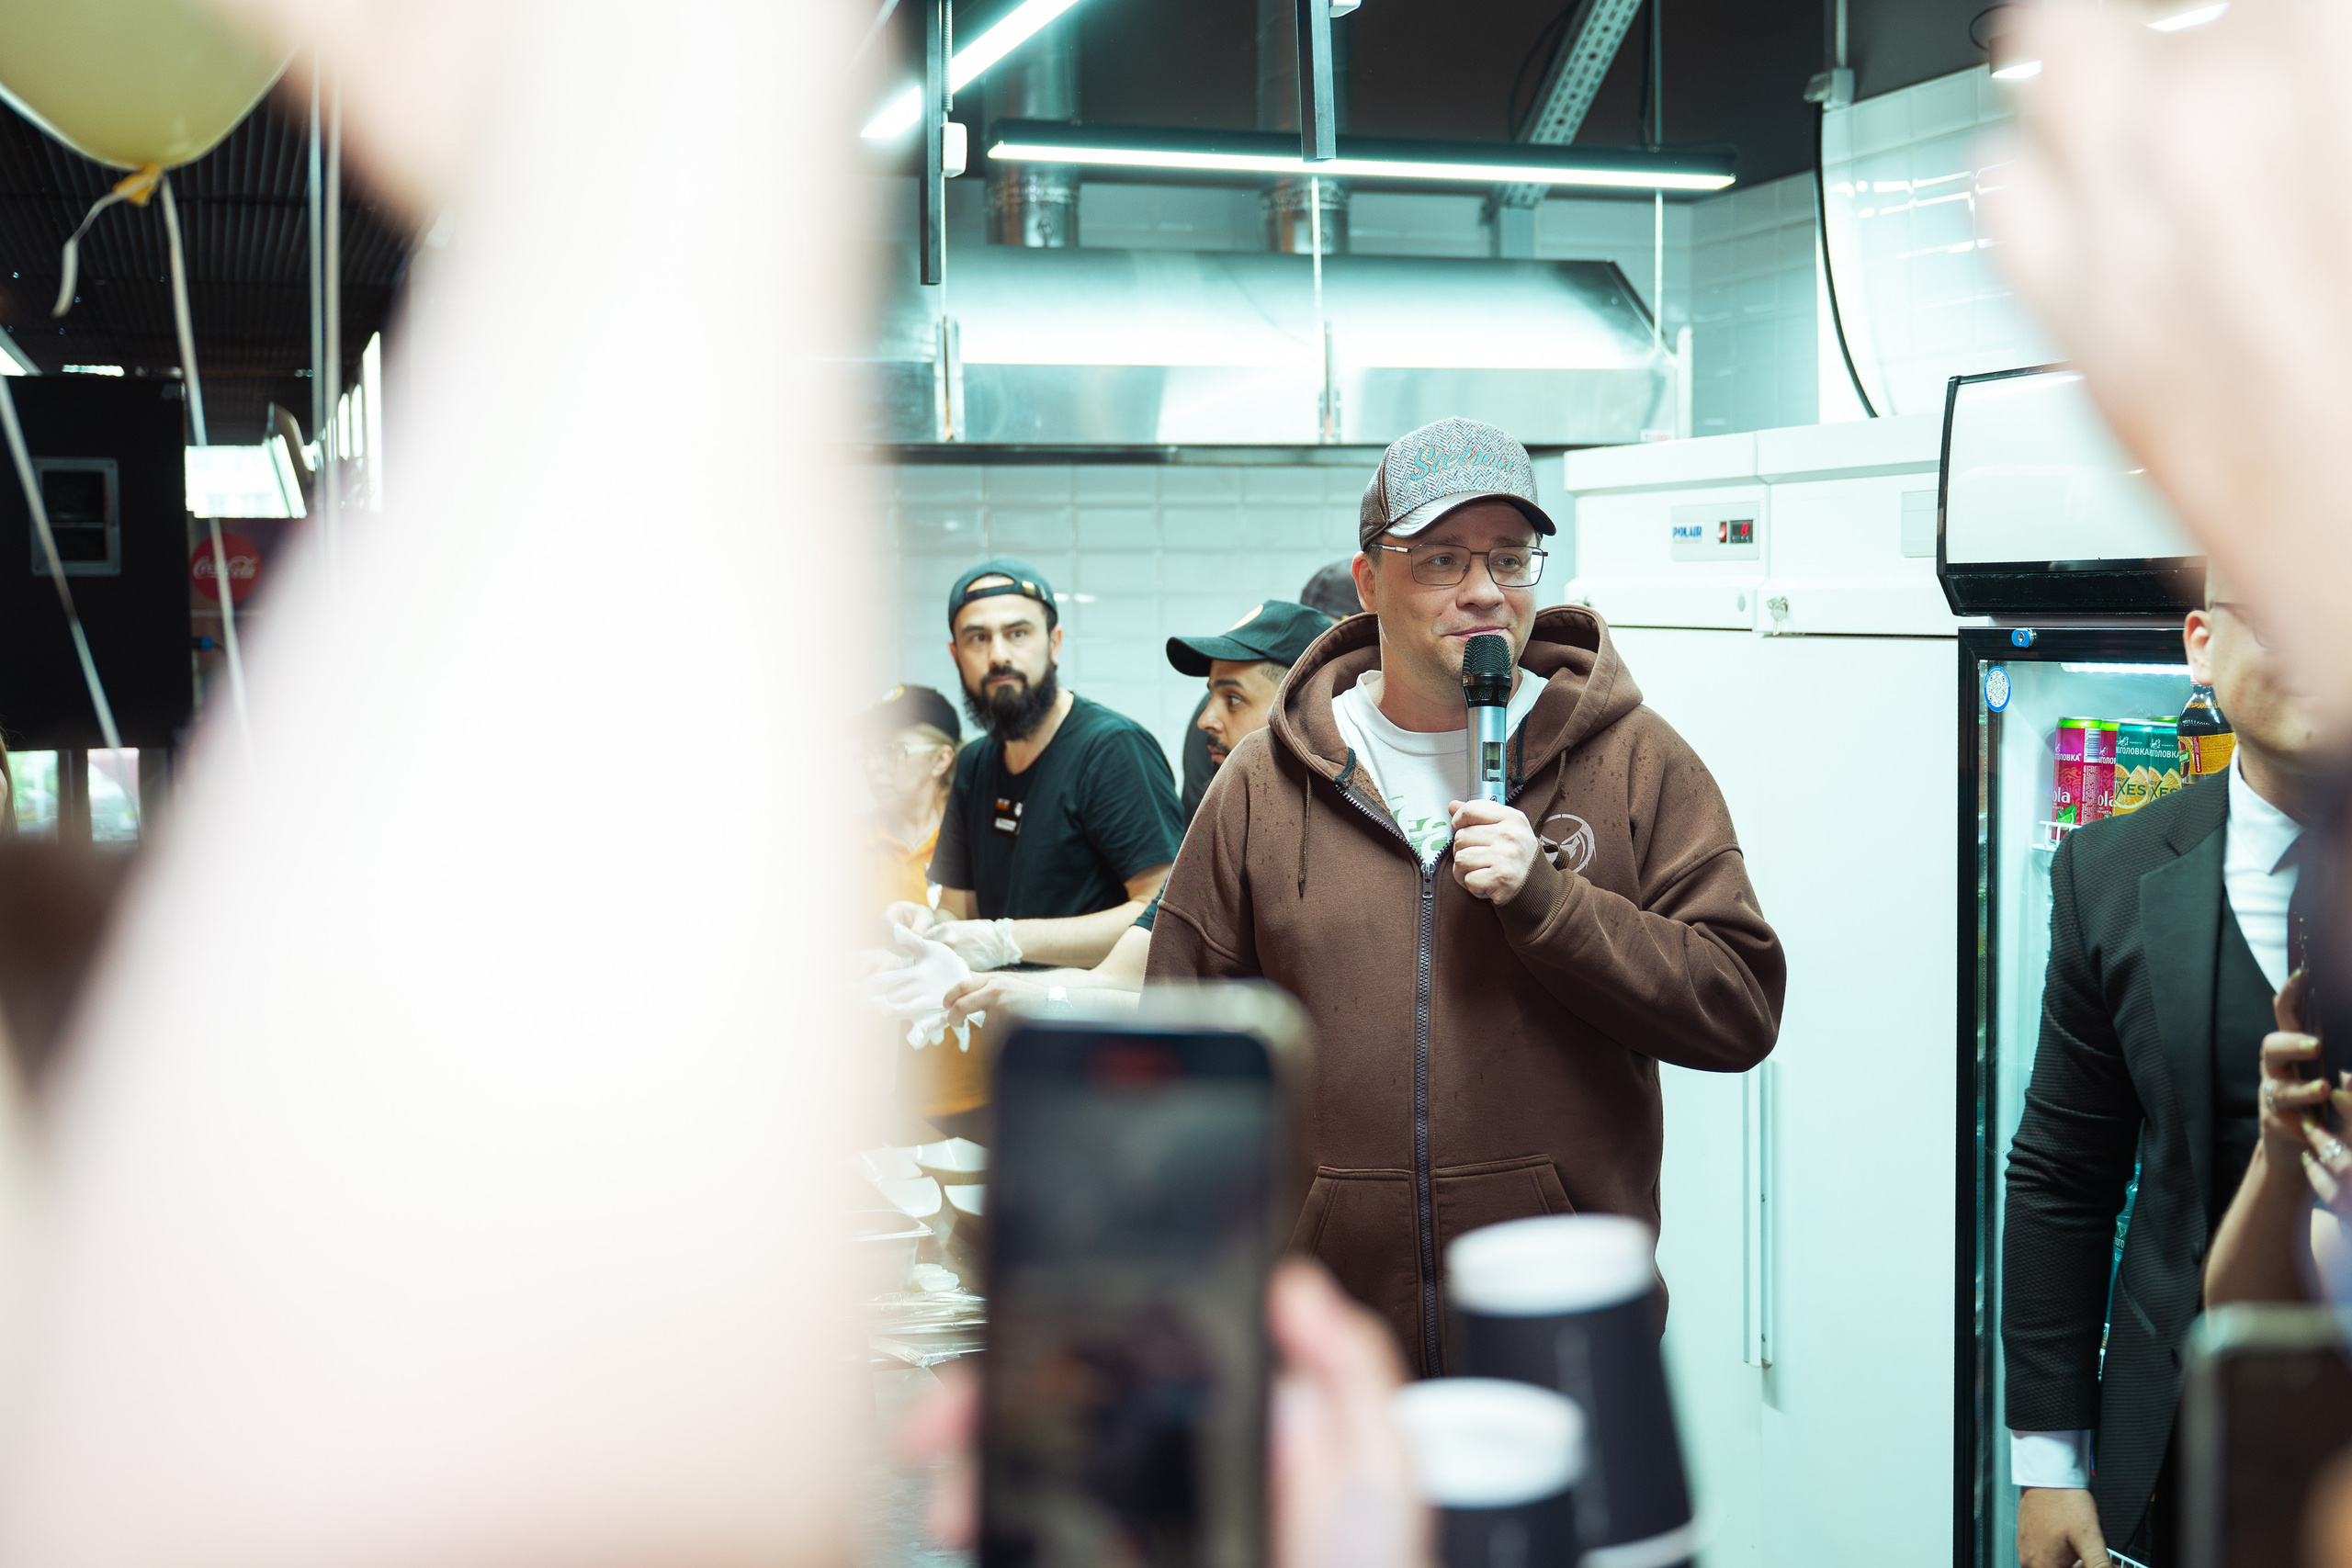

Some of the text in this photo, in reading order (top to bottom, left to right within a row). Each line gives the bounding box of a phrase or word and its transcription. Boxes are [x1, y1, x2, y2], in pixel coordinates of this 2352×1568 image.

[1410, 445, 1514, 481] Stetson
[1672, 525, 1702, 537] POLAIR
[193, 555, 256, 580] CocCola
